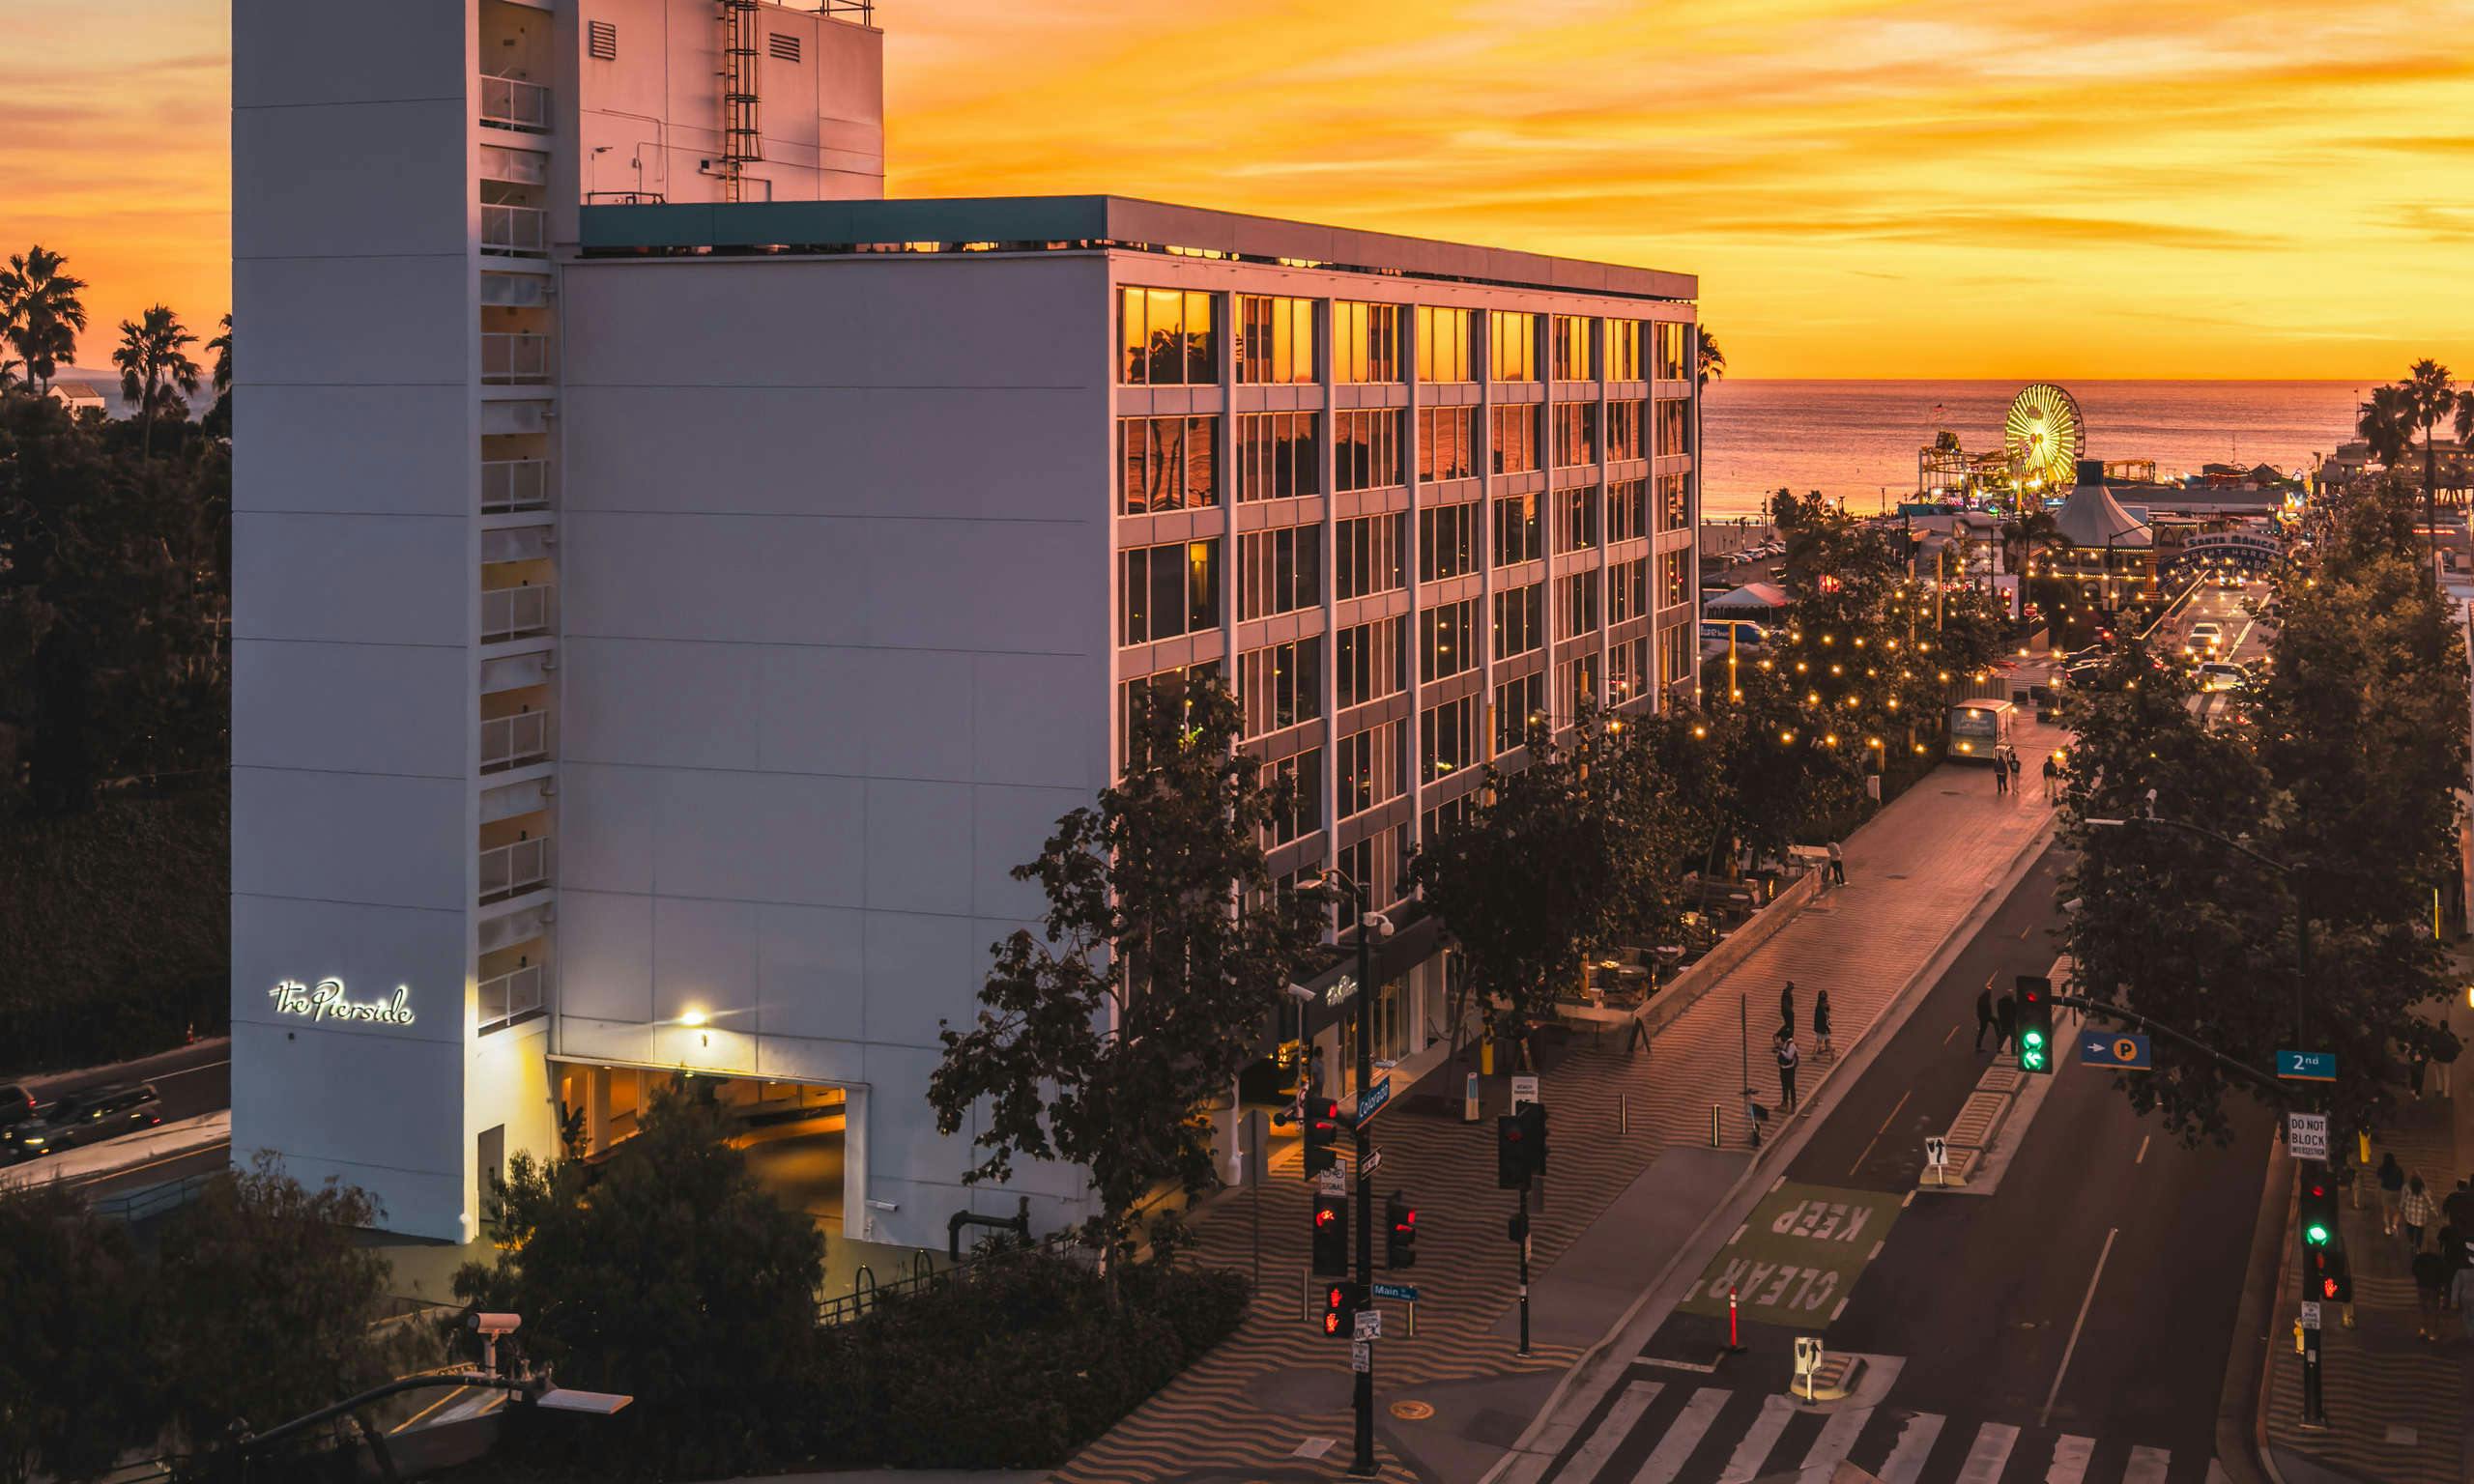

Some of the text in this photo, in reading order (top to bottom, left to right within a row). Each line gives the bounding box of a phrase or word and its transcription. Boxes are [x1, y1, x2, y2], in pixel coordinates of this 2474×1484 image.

[311, 978, 415, 1025] Pierside
[2120, 1043, 2132, 1056] P
[2292, 1054, 2319, 1070] 2nd
[1359, 1081, 1389, 1118] Colorado
[2291, 1119, 2324, 1131] DO NOT
[2291, 1133, 2324, 1146] BLOCK
[1771, 1200, 1873, 1242] KEEP
[1374, 1285, 1399, 1297] Main
[1709, 1258, 1839, 1310] CLEAR
